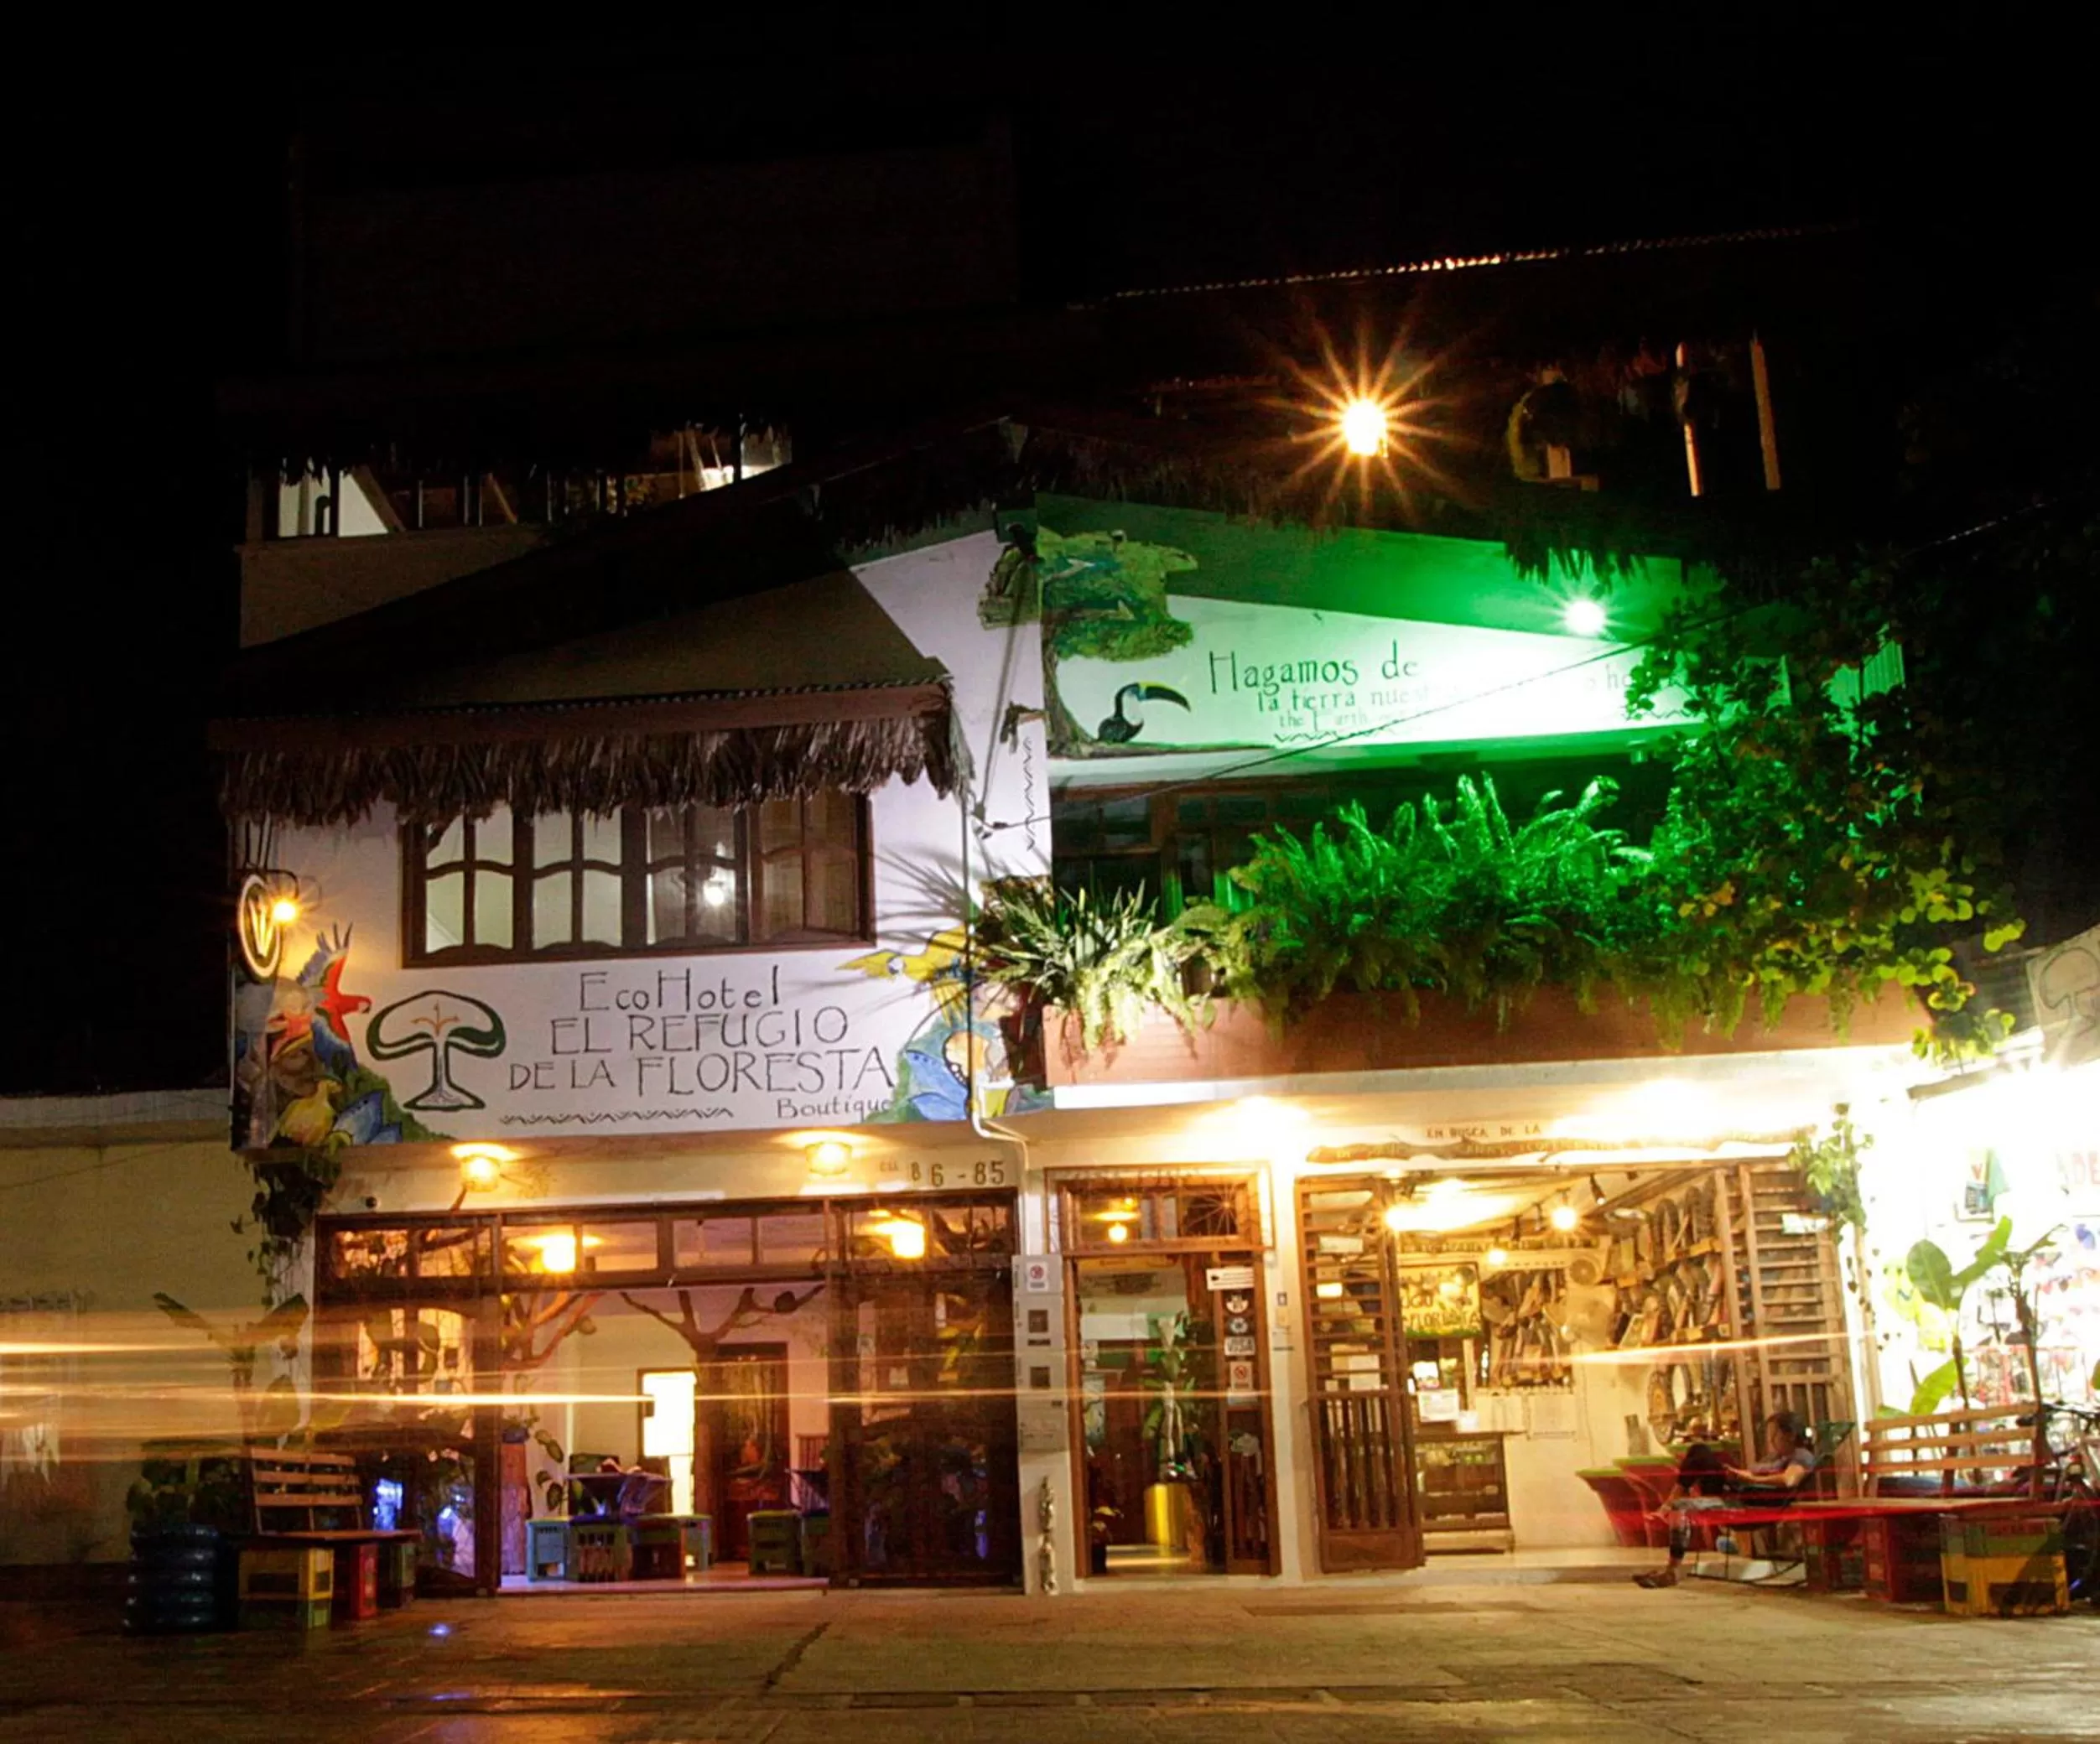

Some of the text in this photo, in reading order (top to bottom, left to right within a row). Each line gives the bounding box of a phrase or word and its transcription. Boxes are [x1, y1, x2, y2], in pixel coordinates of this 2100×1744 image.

[1209, 638, 1418, 697] Hagamos de
[1258, 691, 1280, 713] la
[1292, 688, 1356, 712] tierra
[578, 963, 780, 1012] EcoHotel
[550, 1005, 849, 1056] EL REFUGIO
[509, 1046, 895, 1098] DE LA FLORESTA
[777, 1095, 894, 1124] Boutique
